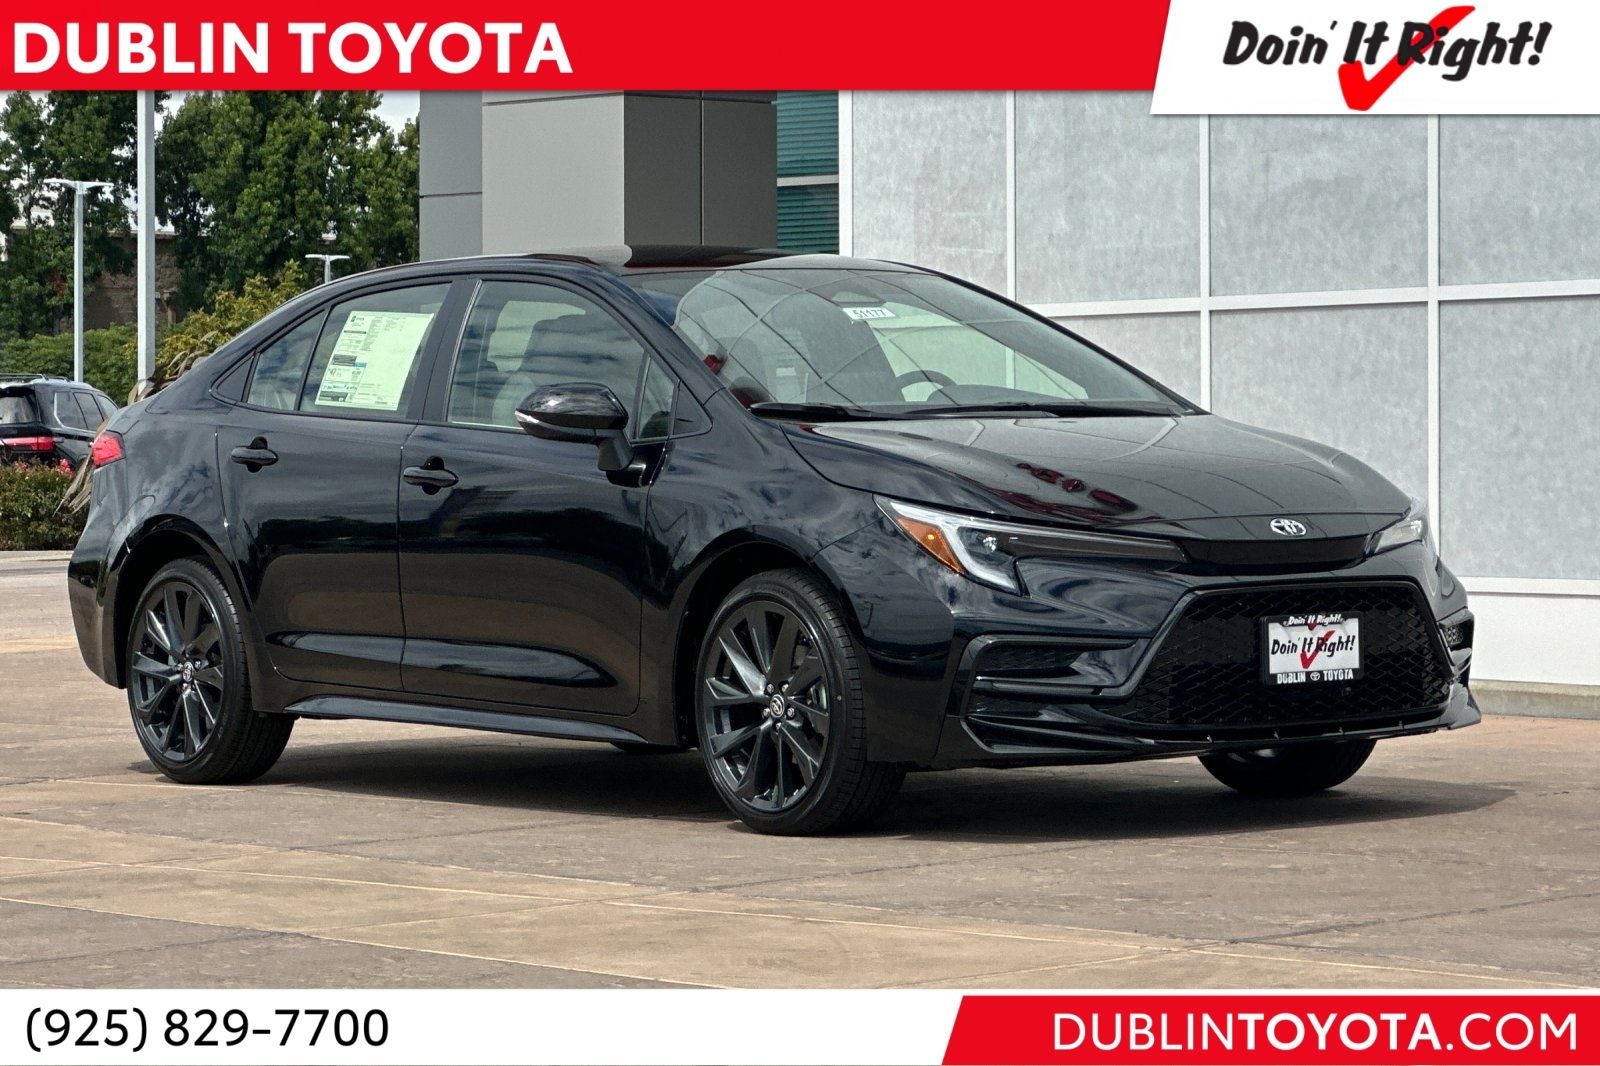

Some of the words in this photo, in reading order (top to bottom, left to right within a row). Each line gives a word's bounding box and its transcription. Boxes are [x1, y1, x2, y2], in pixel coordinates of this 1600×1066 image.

[852, 309, 887, 318] 51177
[1307, 614, 1316, 625] It
[1316, 614, 1342, 626] Right!
[1271, 637, 1301, 656] Doin'
[1302, 637, 1313, 653] It
[1315, 635, 1356, 657] Right!
[1276, 672, 1306, 684] DUBLIN
[1323, 669, 1353, 681] TOYOTA
